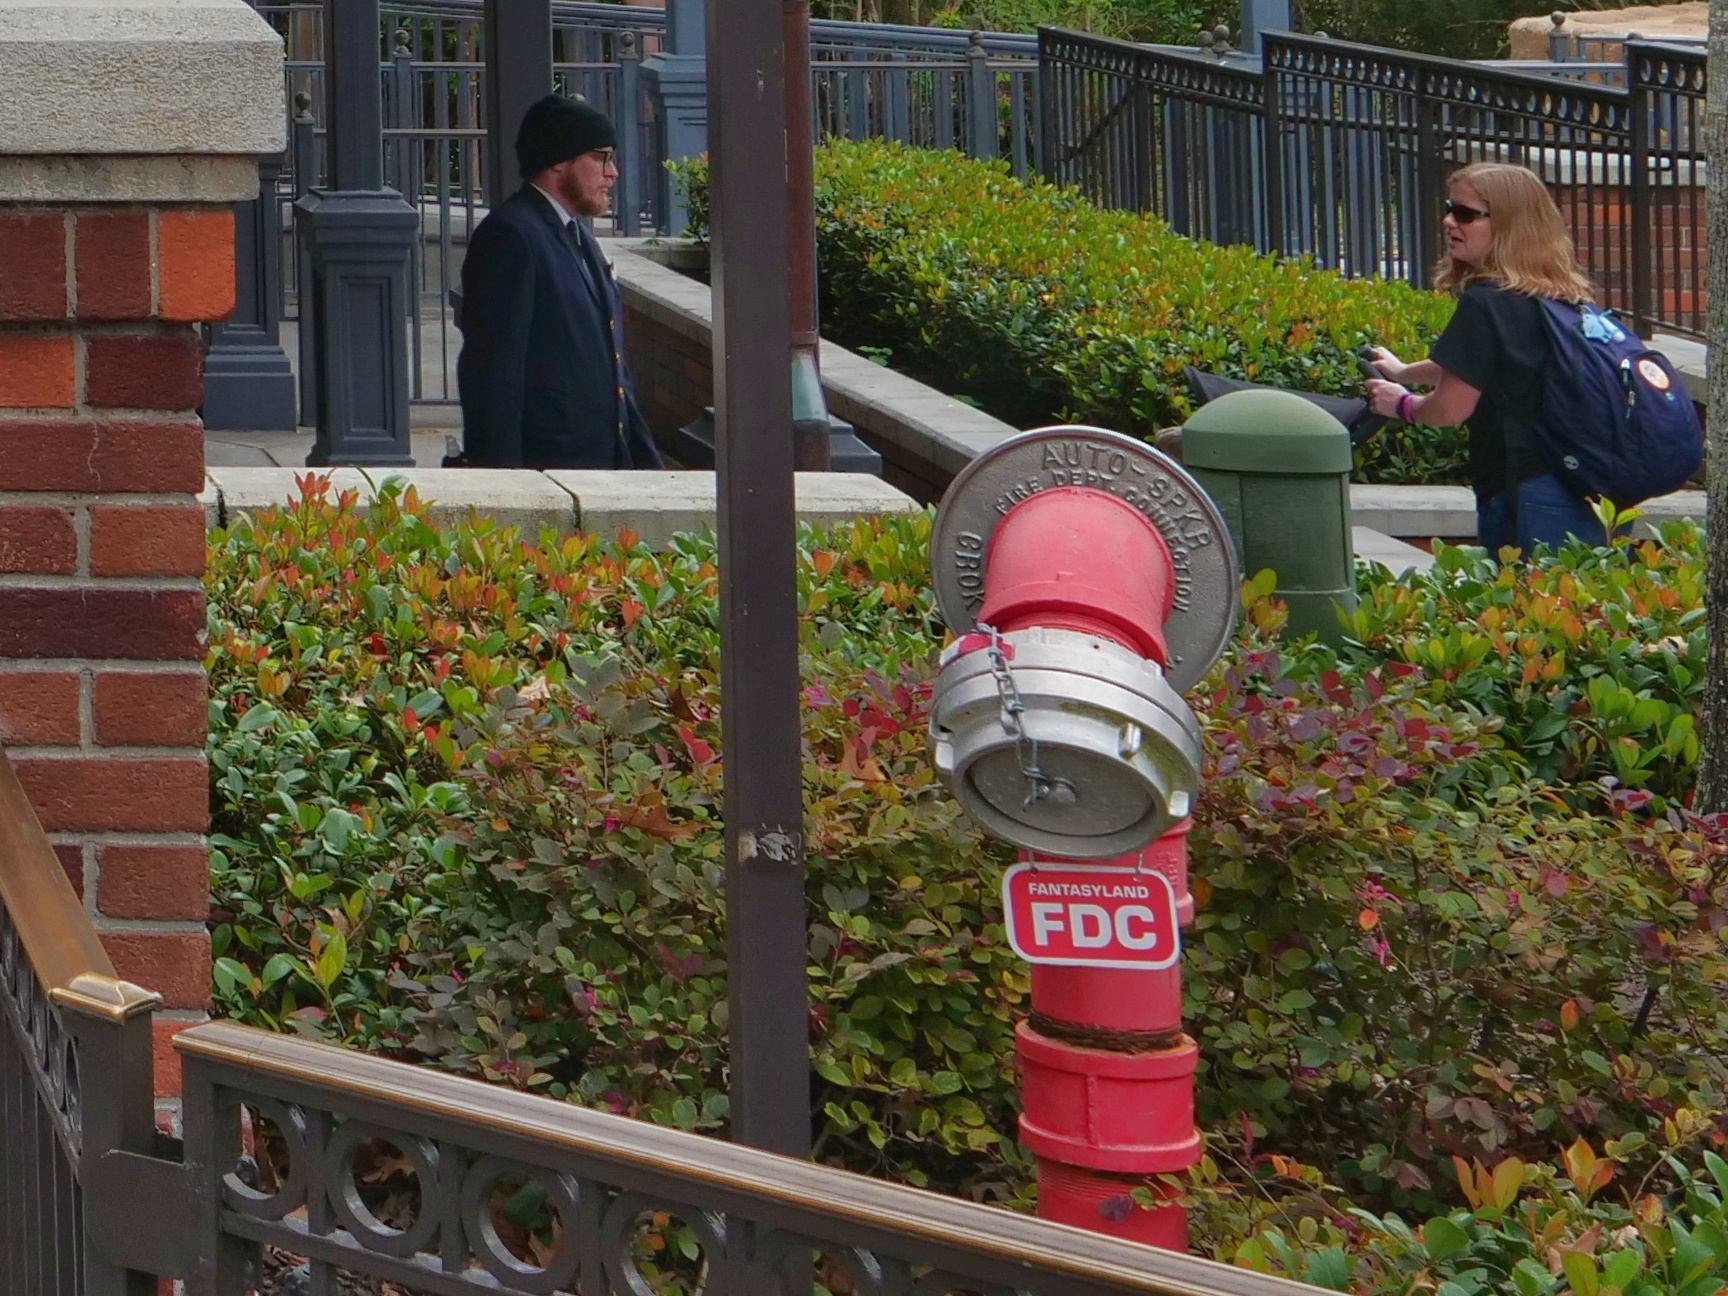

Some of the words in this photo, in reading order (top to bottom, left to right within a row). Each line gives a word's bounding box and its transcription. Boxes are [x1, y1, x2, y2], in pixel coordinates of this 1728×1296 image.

[993, 476, 1043, 516] FIRE
[1028, 882, 1149, 899] FANTASYLAND
[1030, 901, 1157, 950] FDC
